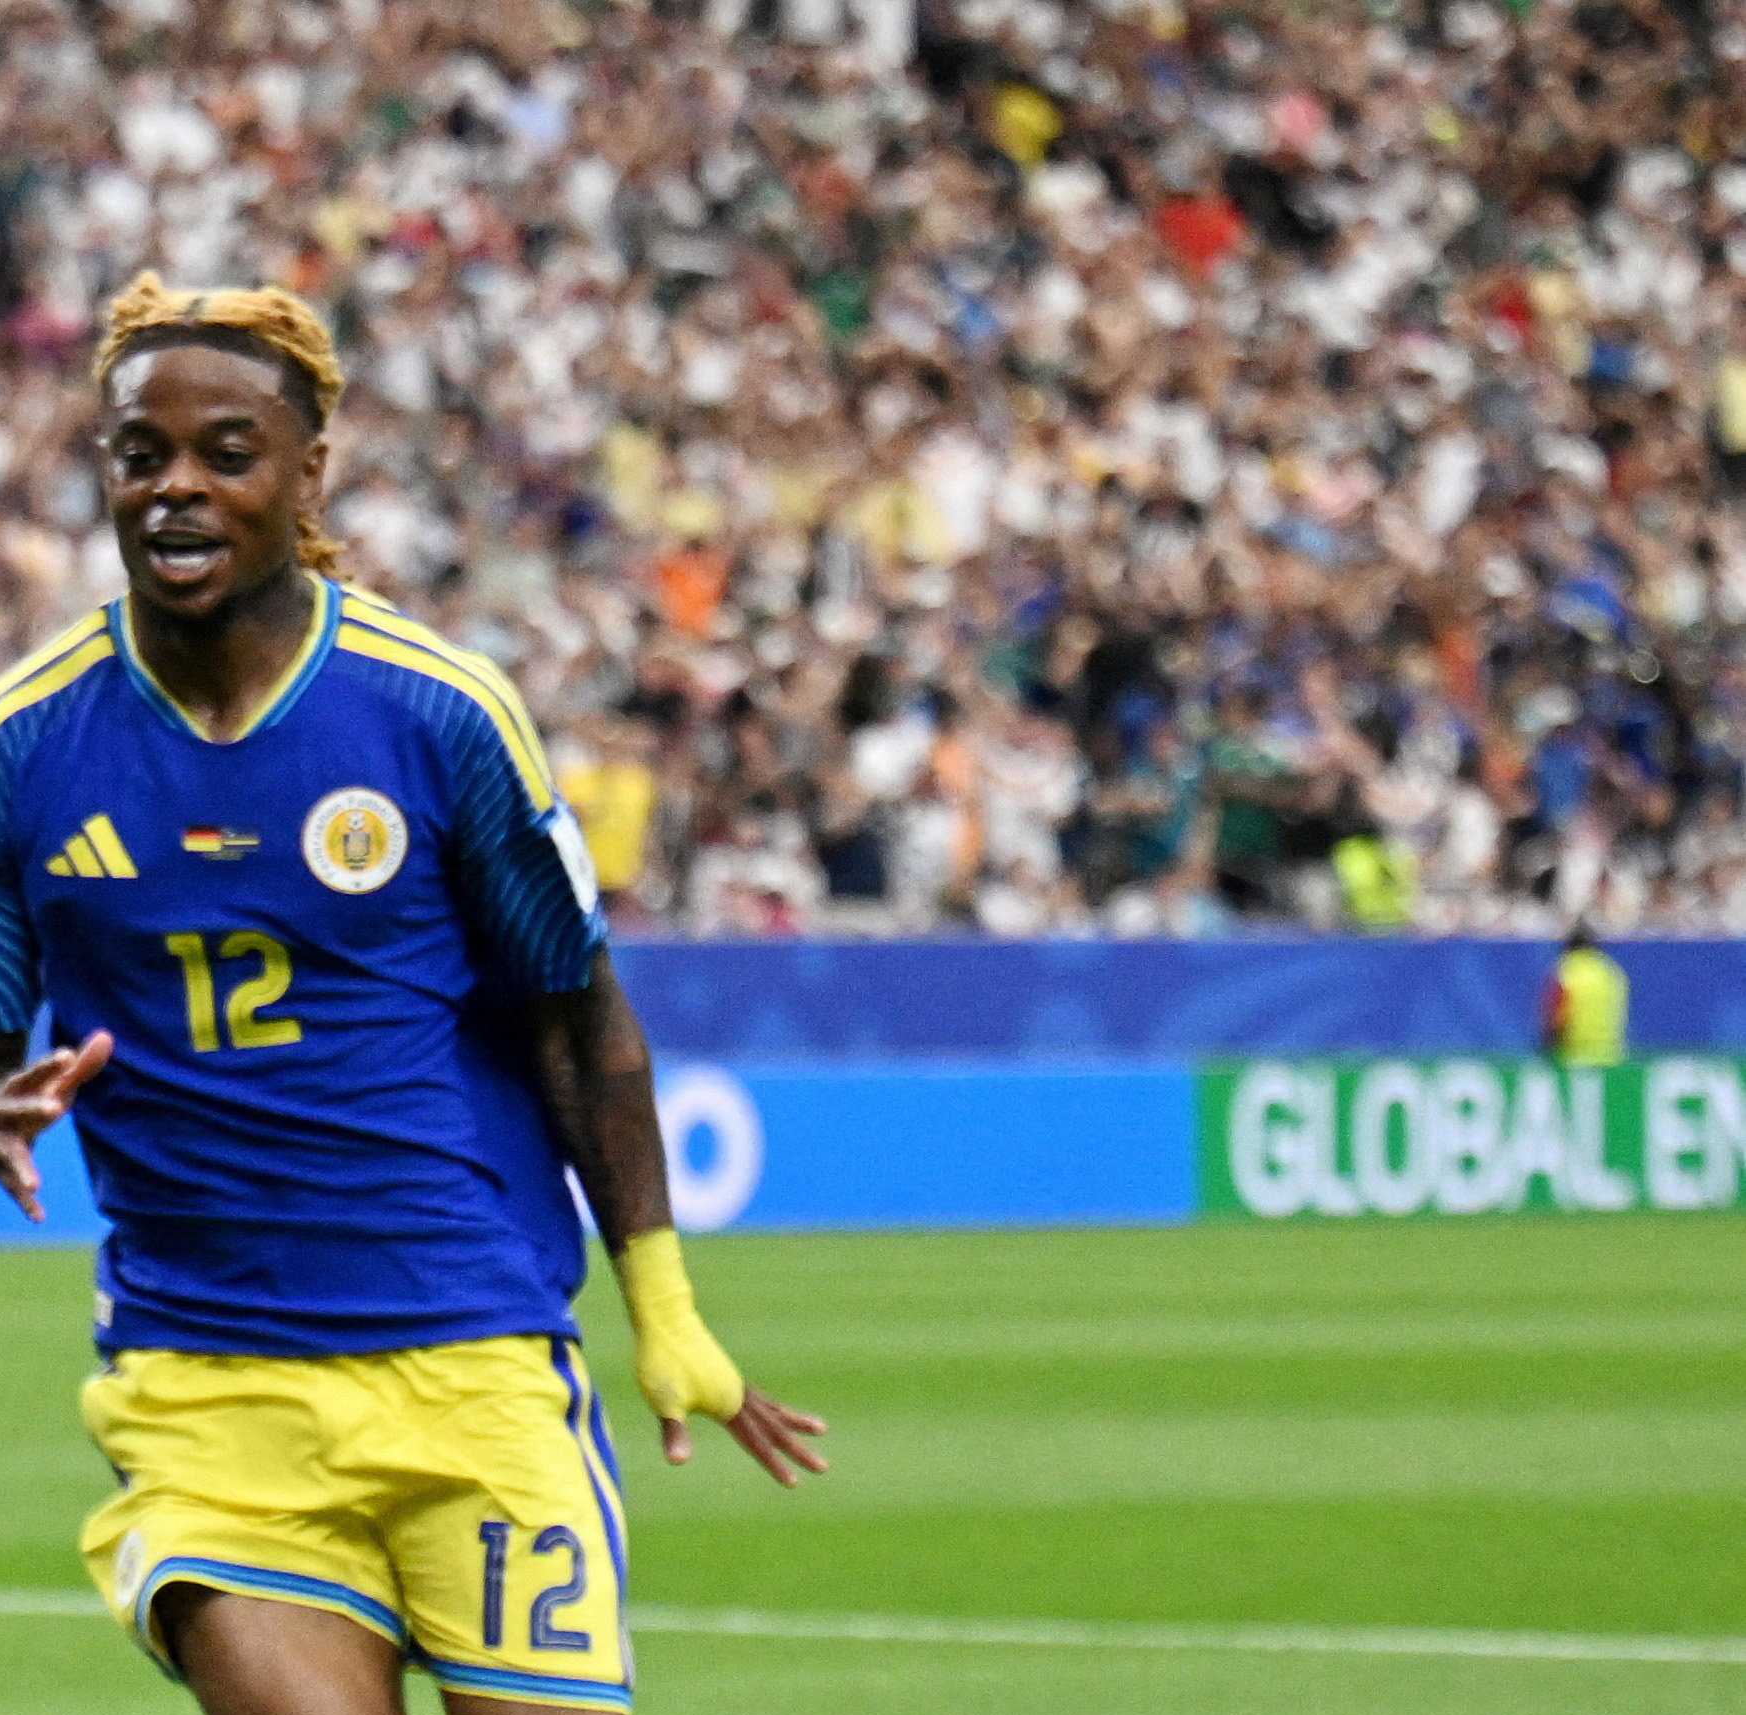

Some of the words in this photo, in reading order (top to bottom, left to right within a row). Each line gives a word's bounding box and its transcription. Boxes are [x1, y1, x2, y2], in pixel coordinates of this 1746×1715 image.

[164, 930, 302, 1053] 12
[1227, 1058, 1637, 1217] GLOBAL
[478, 1519, 592, 1652] 12
